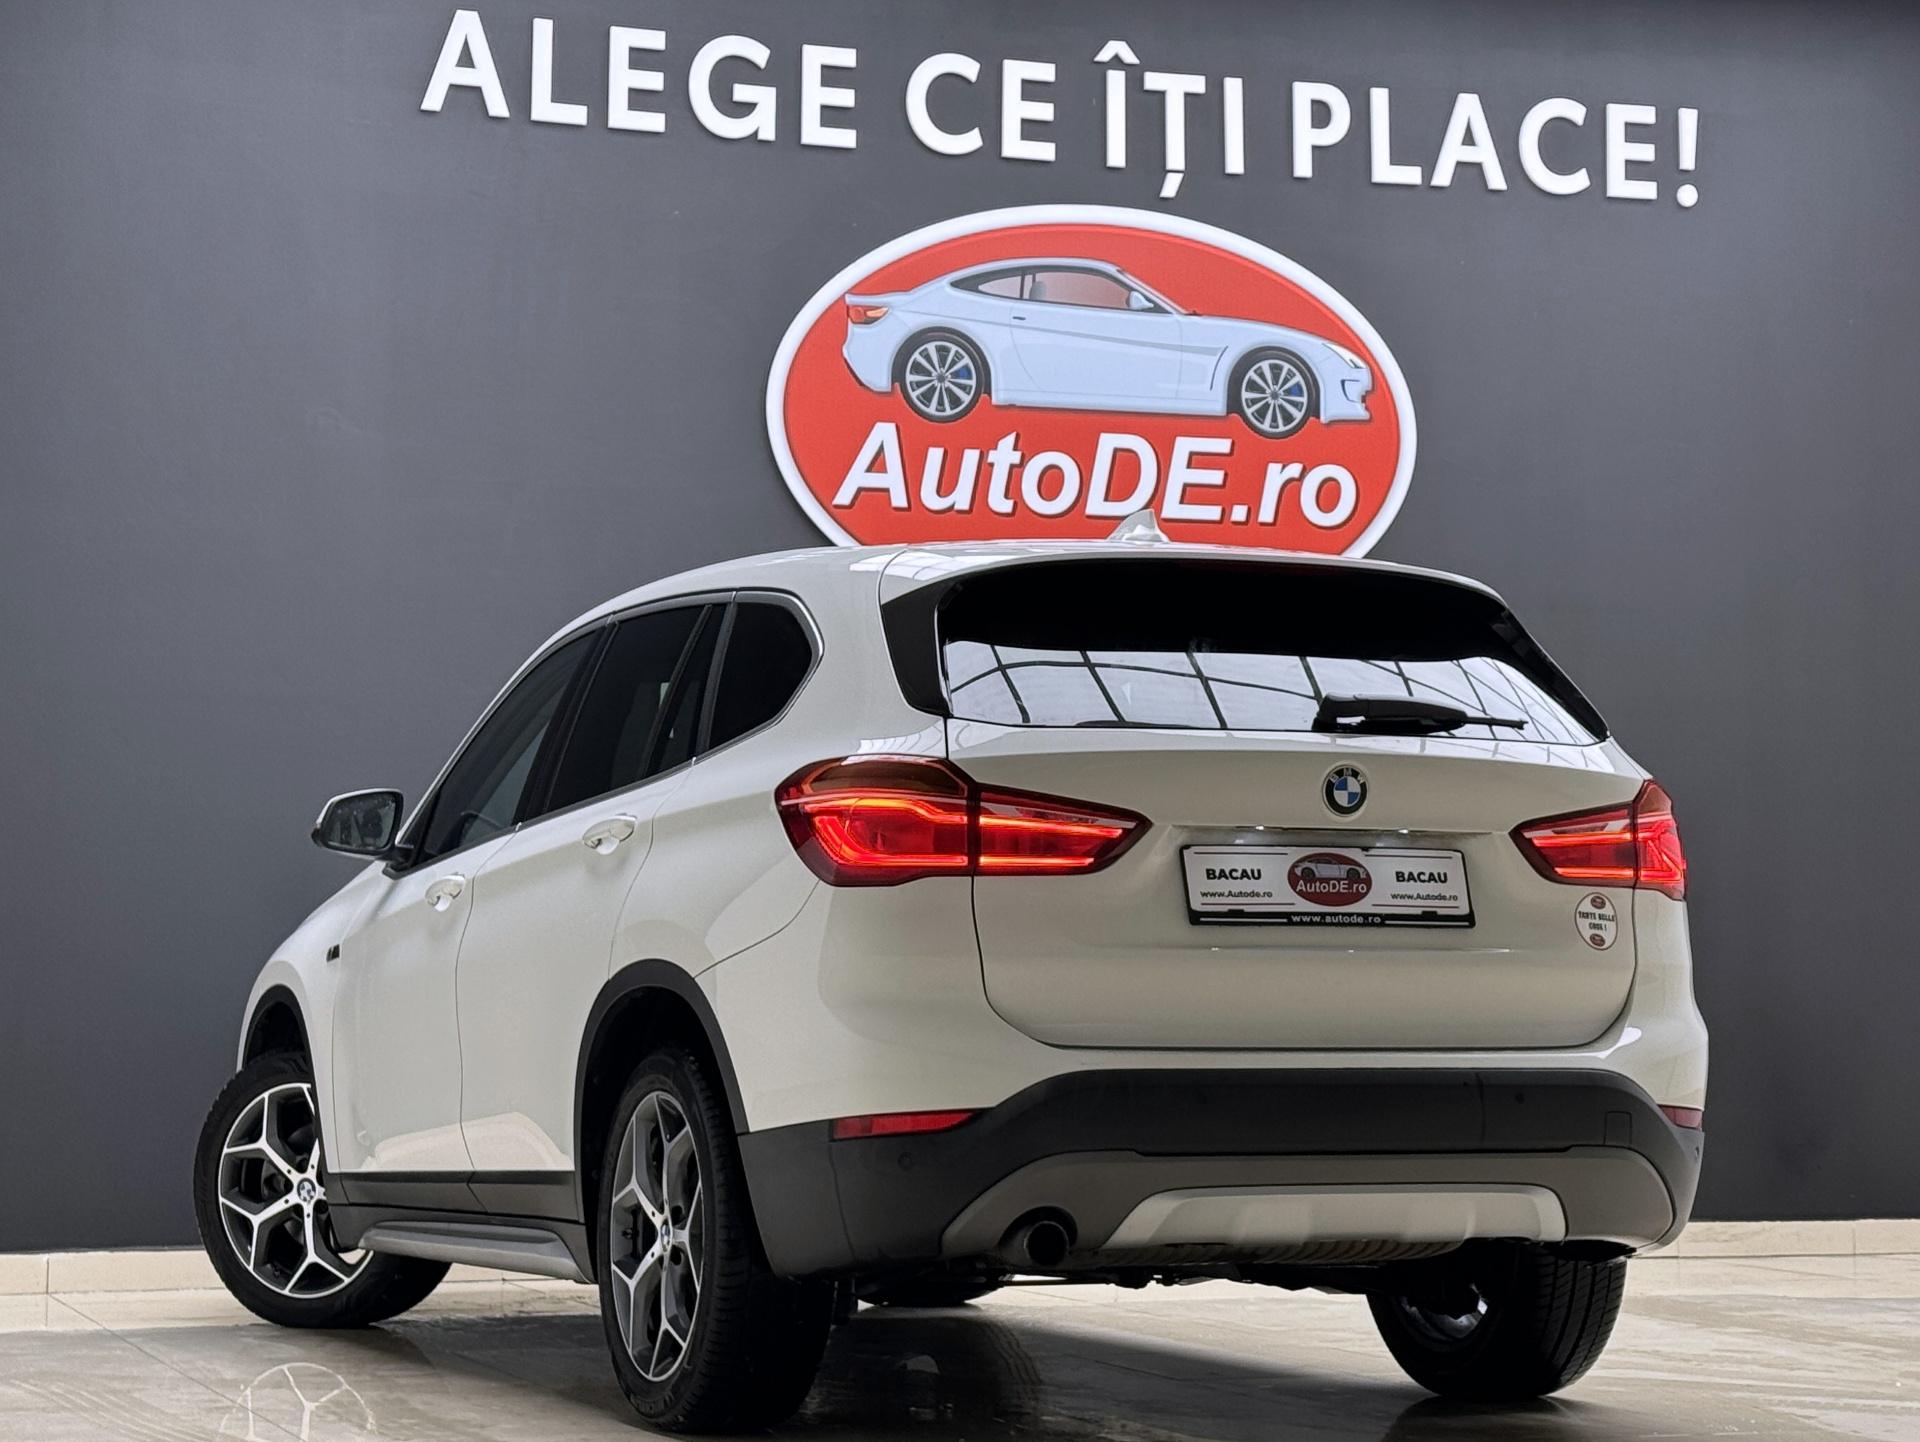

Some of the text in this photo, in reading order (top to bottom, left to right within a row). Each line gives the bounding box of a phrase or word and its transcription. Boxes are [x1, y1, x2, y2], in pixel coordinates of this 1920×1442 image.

[420, 9, 857, 148] ALEGE
[905, 52, 1056, 162] CE
[1292, 81, 1700, 208] PLACE!
[832, 421, 1358, 528] AutoDE.ro
[1330, 767, 1366, 784] BMW
[1205, 868, 1262, 881] BACAU
[1395, 871, 1448, 884] BACAU
[1296, 880, 1367, 893] AutoDE.ro
[1200, 890, 1273, 898] www.Autode.ro
[1390, 892, 1458, 901] www.Autode.ro
[1291, 914, 1381, 924] www.autode.ro
